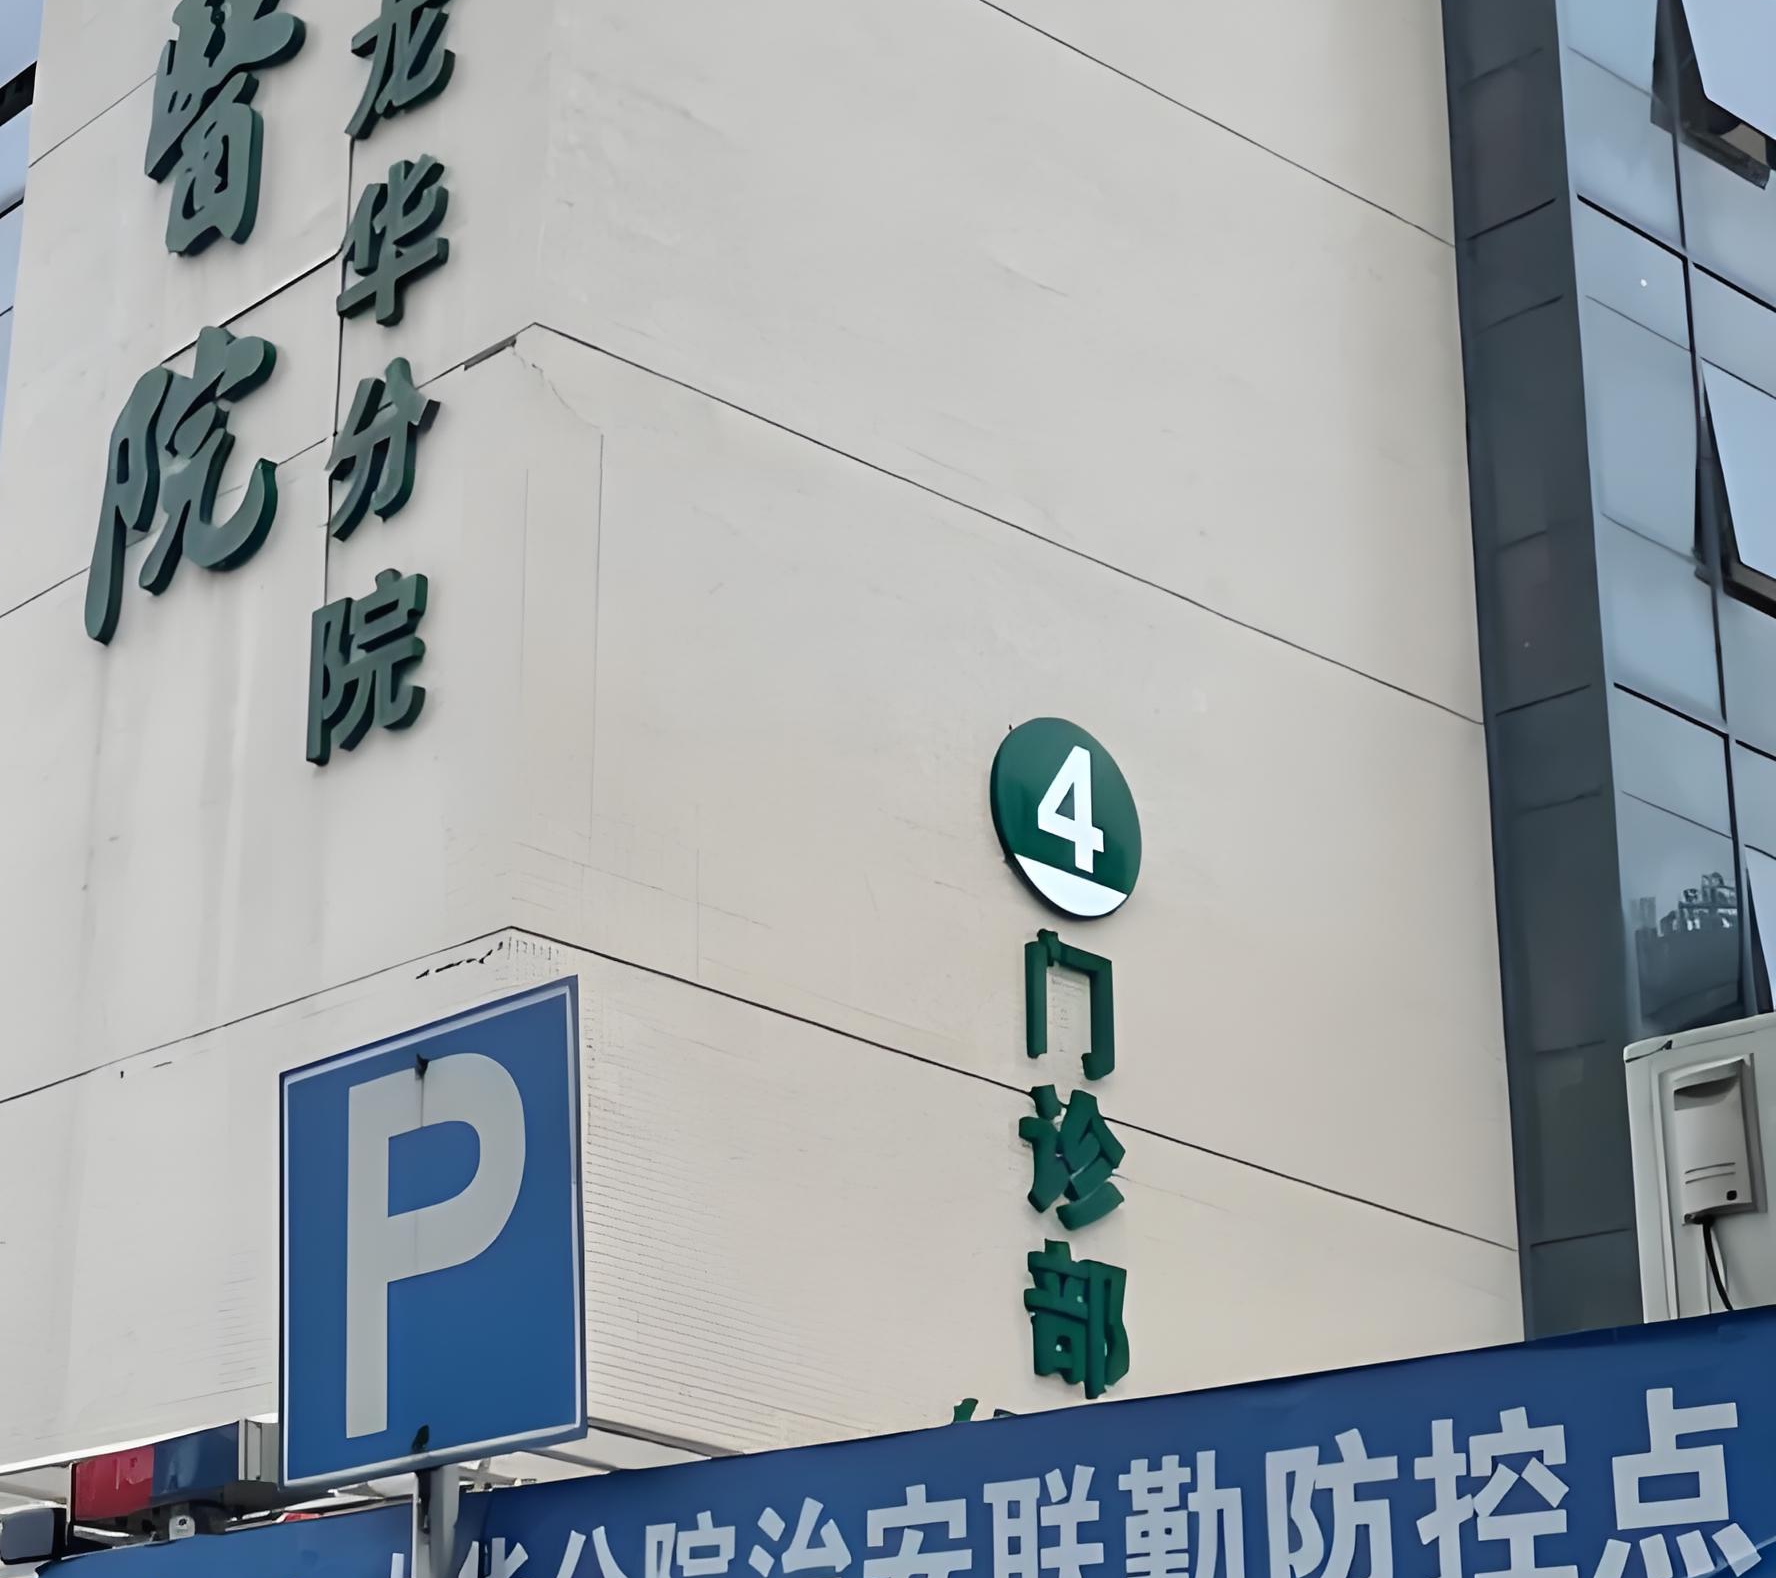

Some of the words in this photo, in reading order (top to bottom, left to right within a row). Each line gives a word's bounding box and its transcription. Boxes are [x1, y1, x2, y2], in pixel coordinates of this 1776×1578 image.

[1037, 745, 1106, 874] 4
[346, 1052, 526, 1439] P
[1018, 928, 1131, 1400] 门诊部
